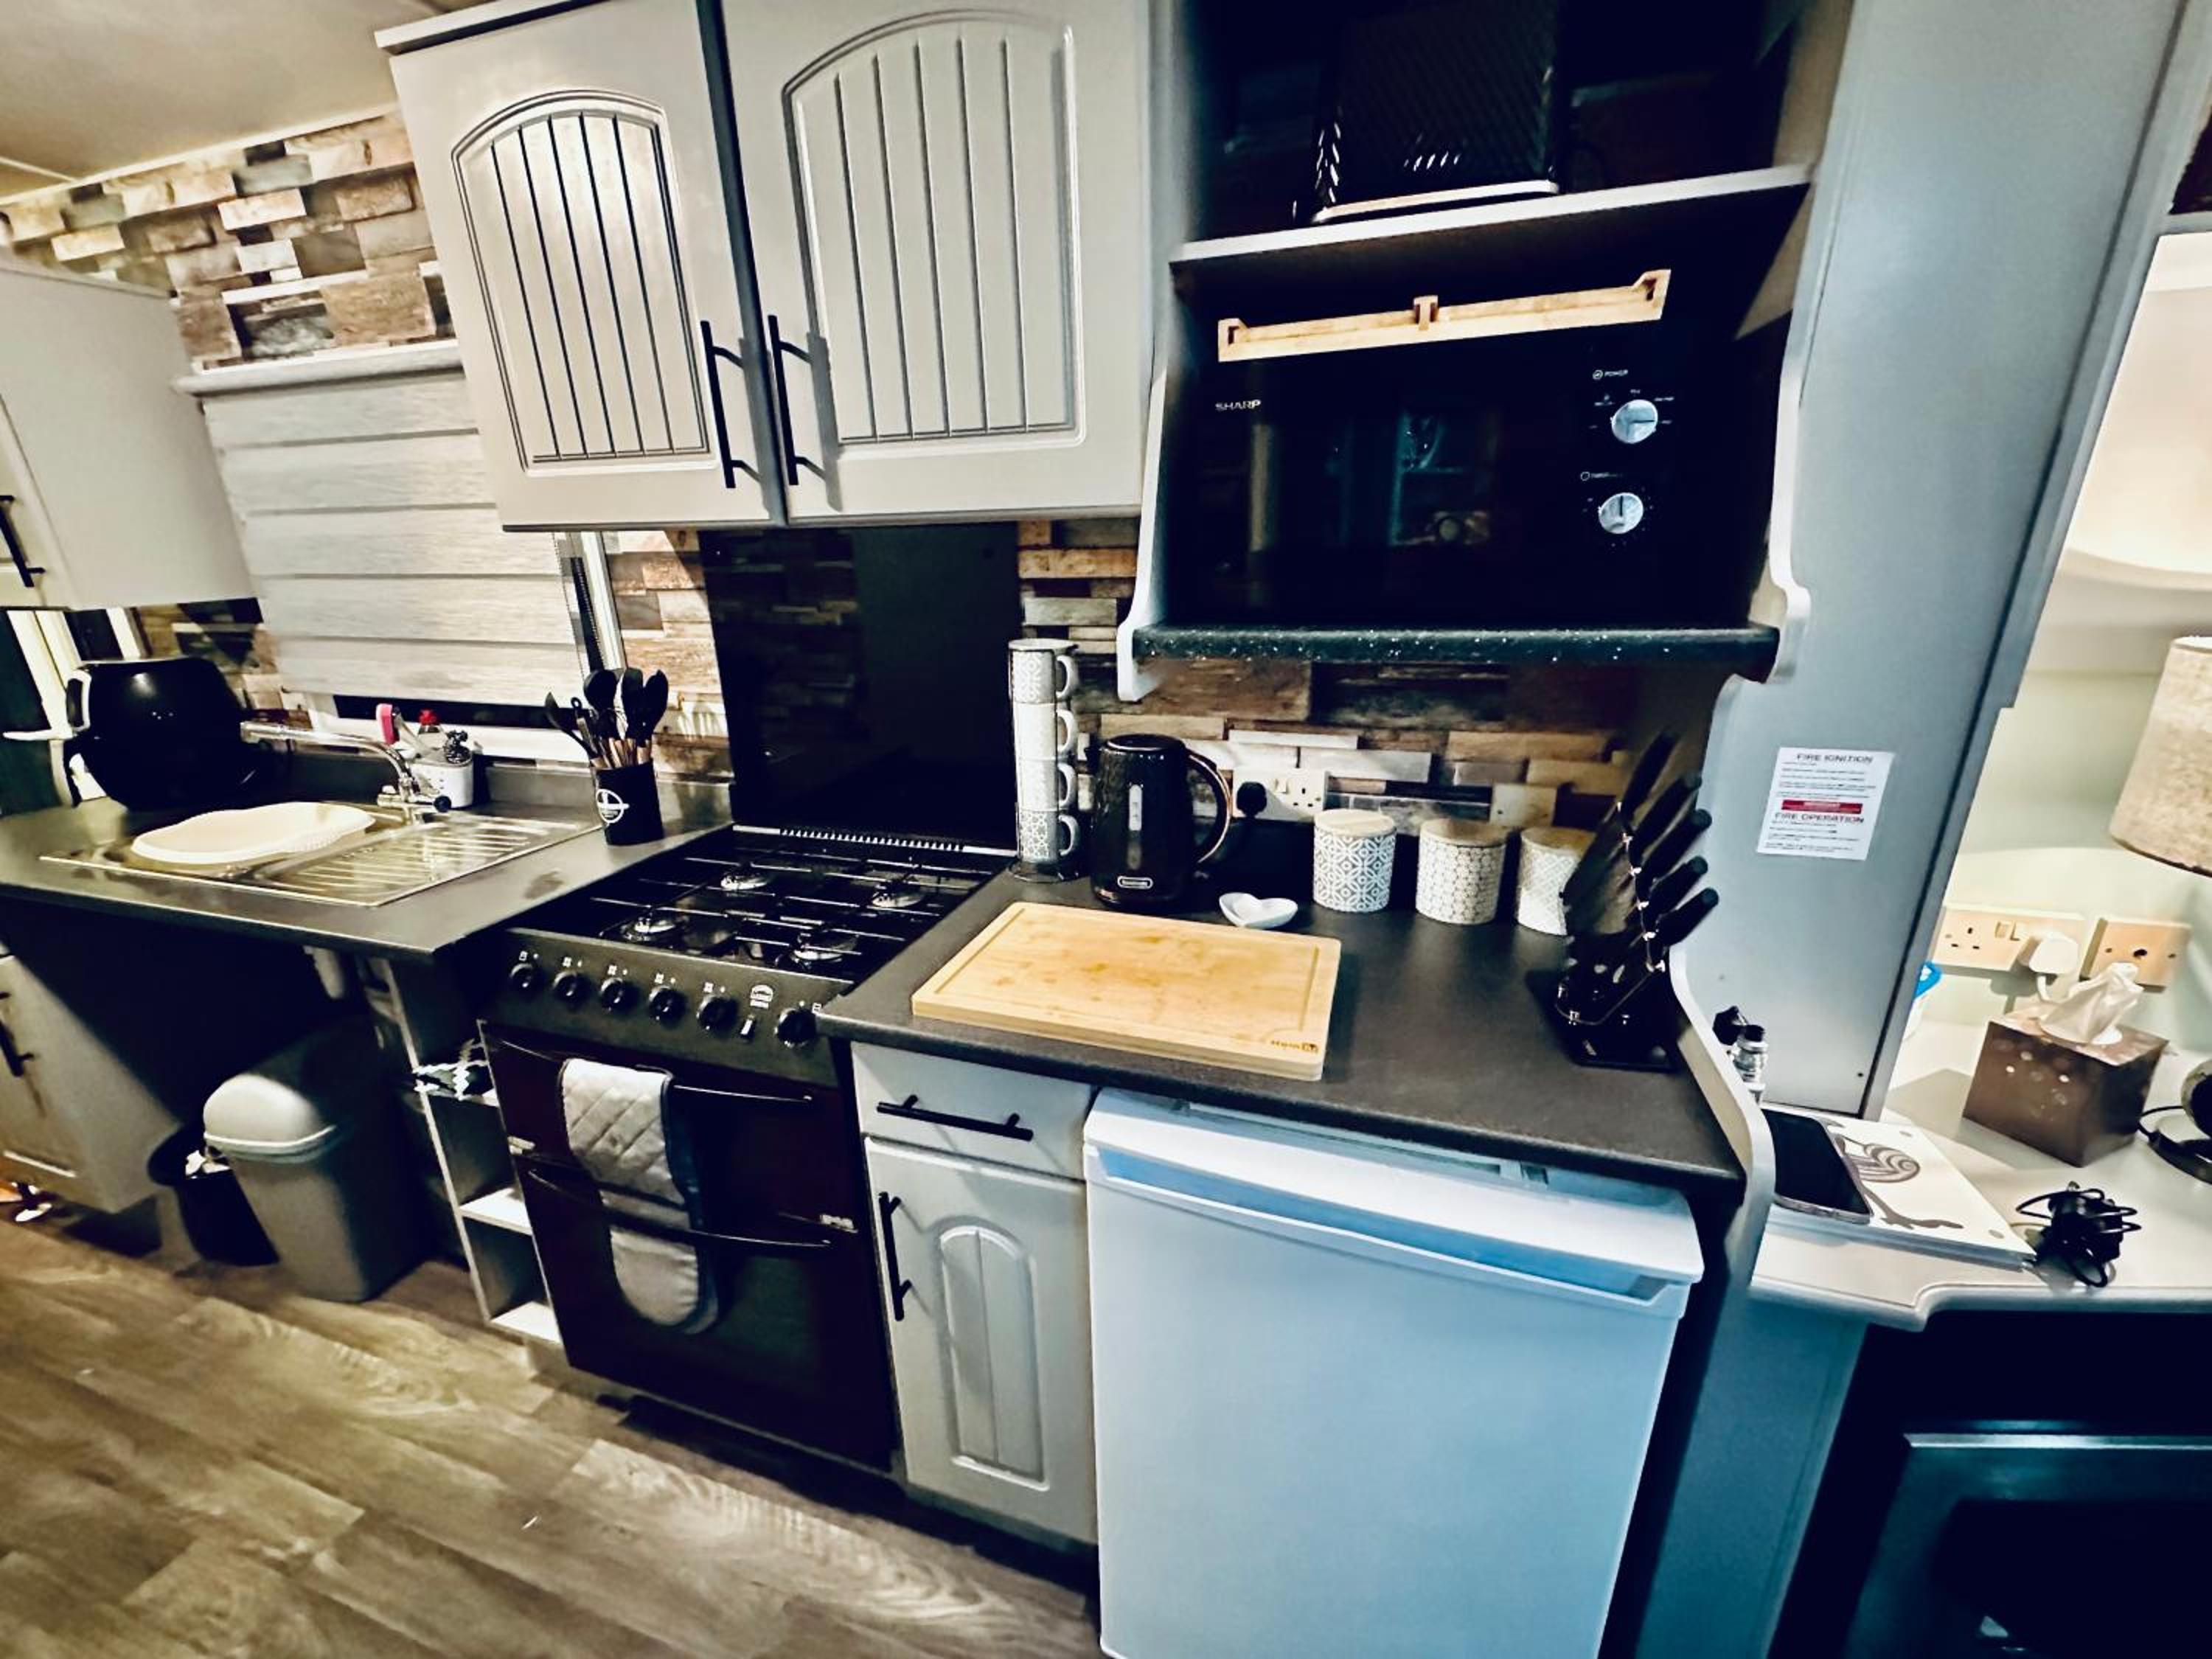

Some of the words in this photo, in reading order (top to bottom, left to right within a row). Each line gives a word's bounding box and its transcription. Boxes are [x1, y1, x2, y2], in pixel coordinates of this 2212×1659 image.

[1215, 399, 1261, 411] SHARP
[1797, 754, 1820, 762] FIRE
[1824, 754, 1873, 764] IGNITION
[1801, 813, 1864, 823] OPERATION
